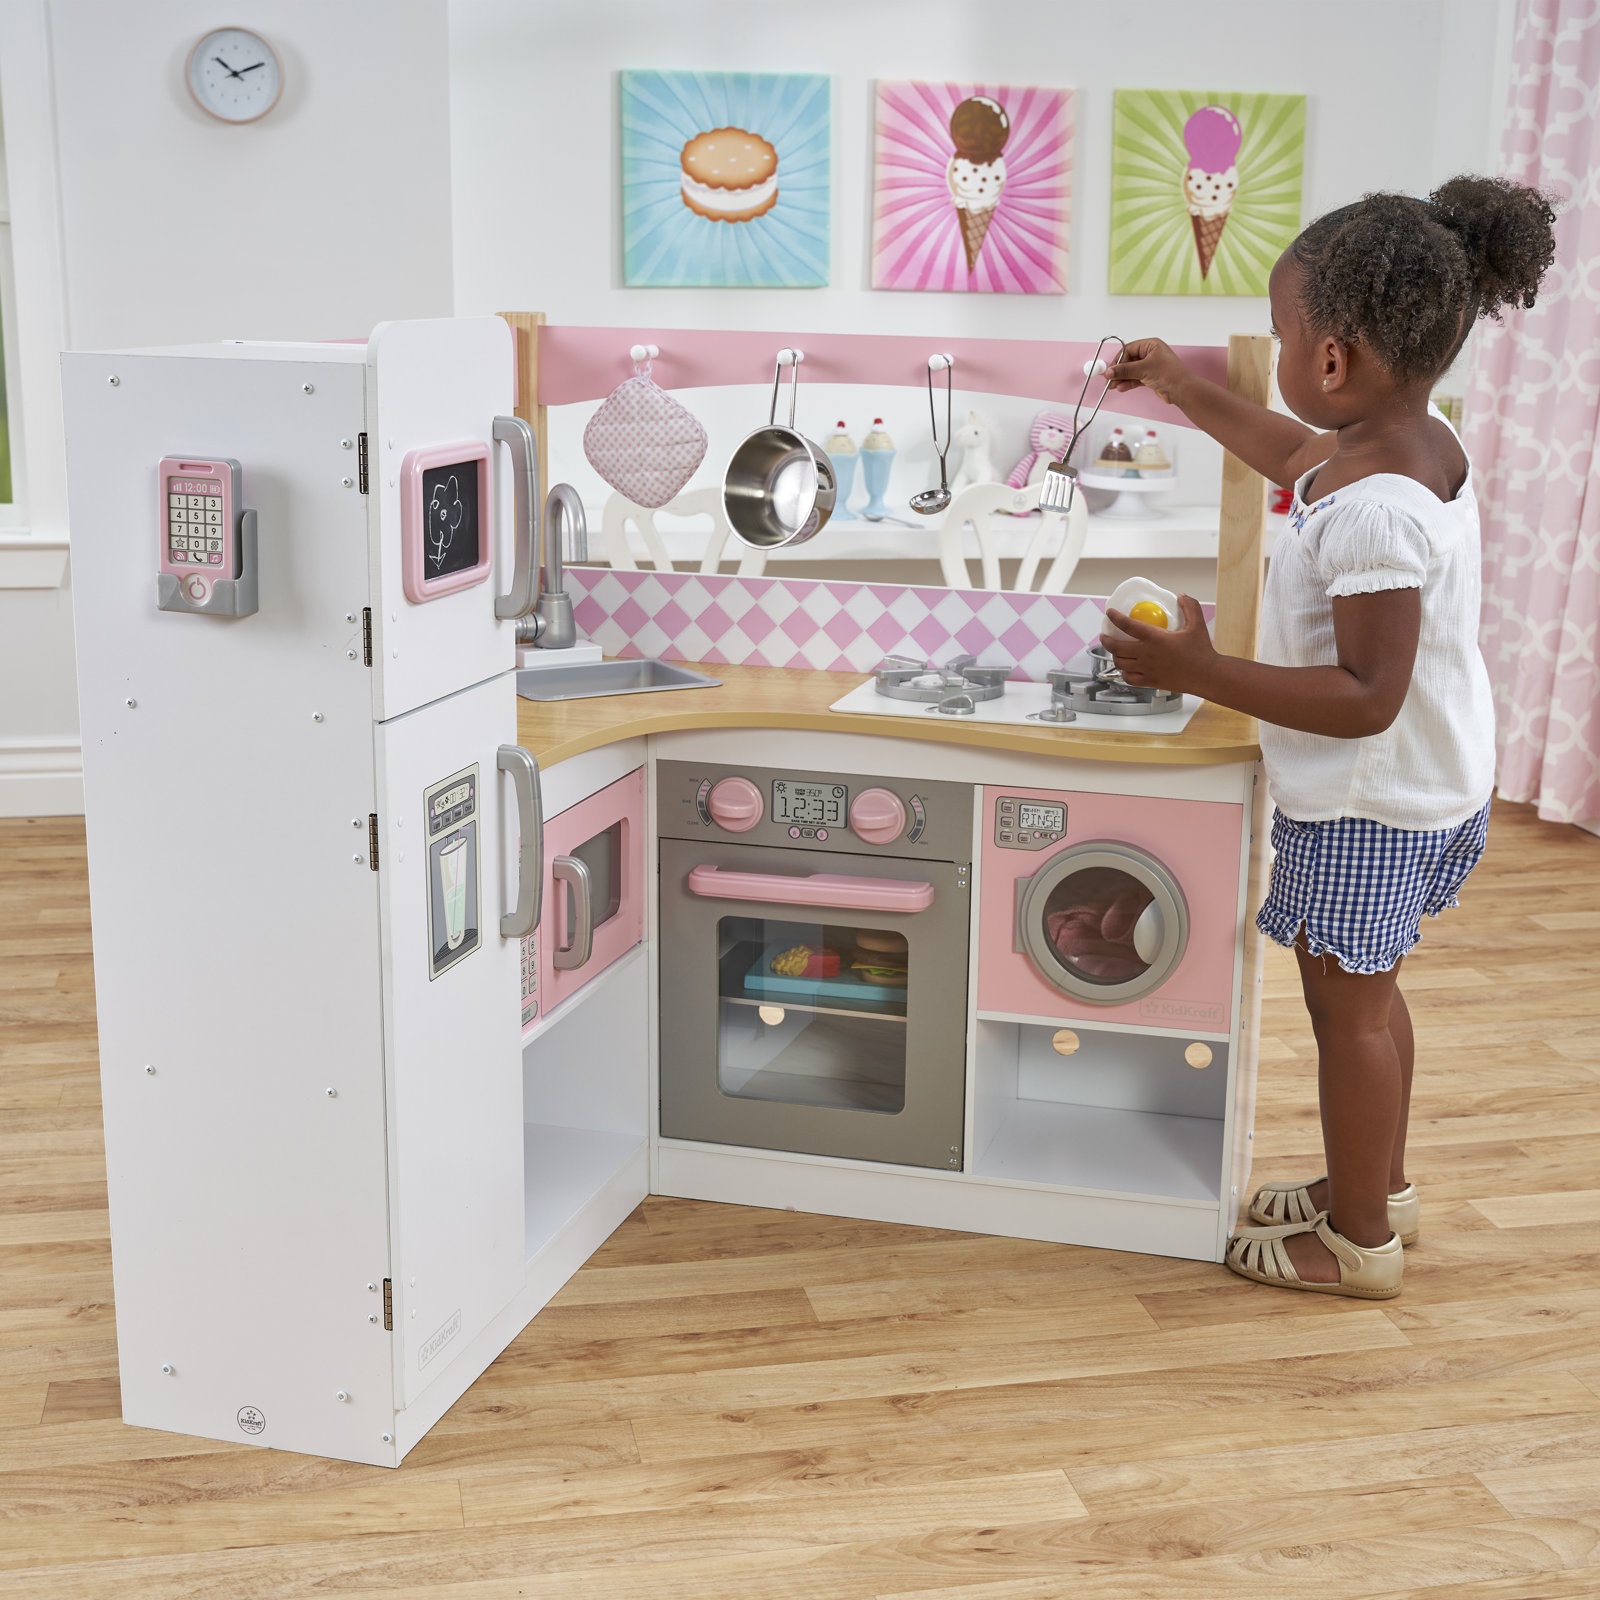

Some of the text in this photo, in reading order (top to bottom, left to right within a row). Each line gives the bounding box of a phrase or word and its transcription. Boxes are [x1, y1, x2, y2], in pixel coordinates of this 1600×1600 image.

[184, 482, 208, 493] 12:00
[177, 497, 216, 508] 1 2 3
[176, 511, 217, 521] 4 5 6
[177, 525, 217, 536] 7 8 9
[194, 540, 200, 549] 0
[780, 796, 839, 822] 12:33
[1021, 812, 1061, 829] RINSE
[1161, 1003, 1218, 1019] KidKraft
